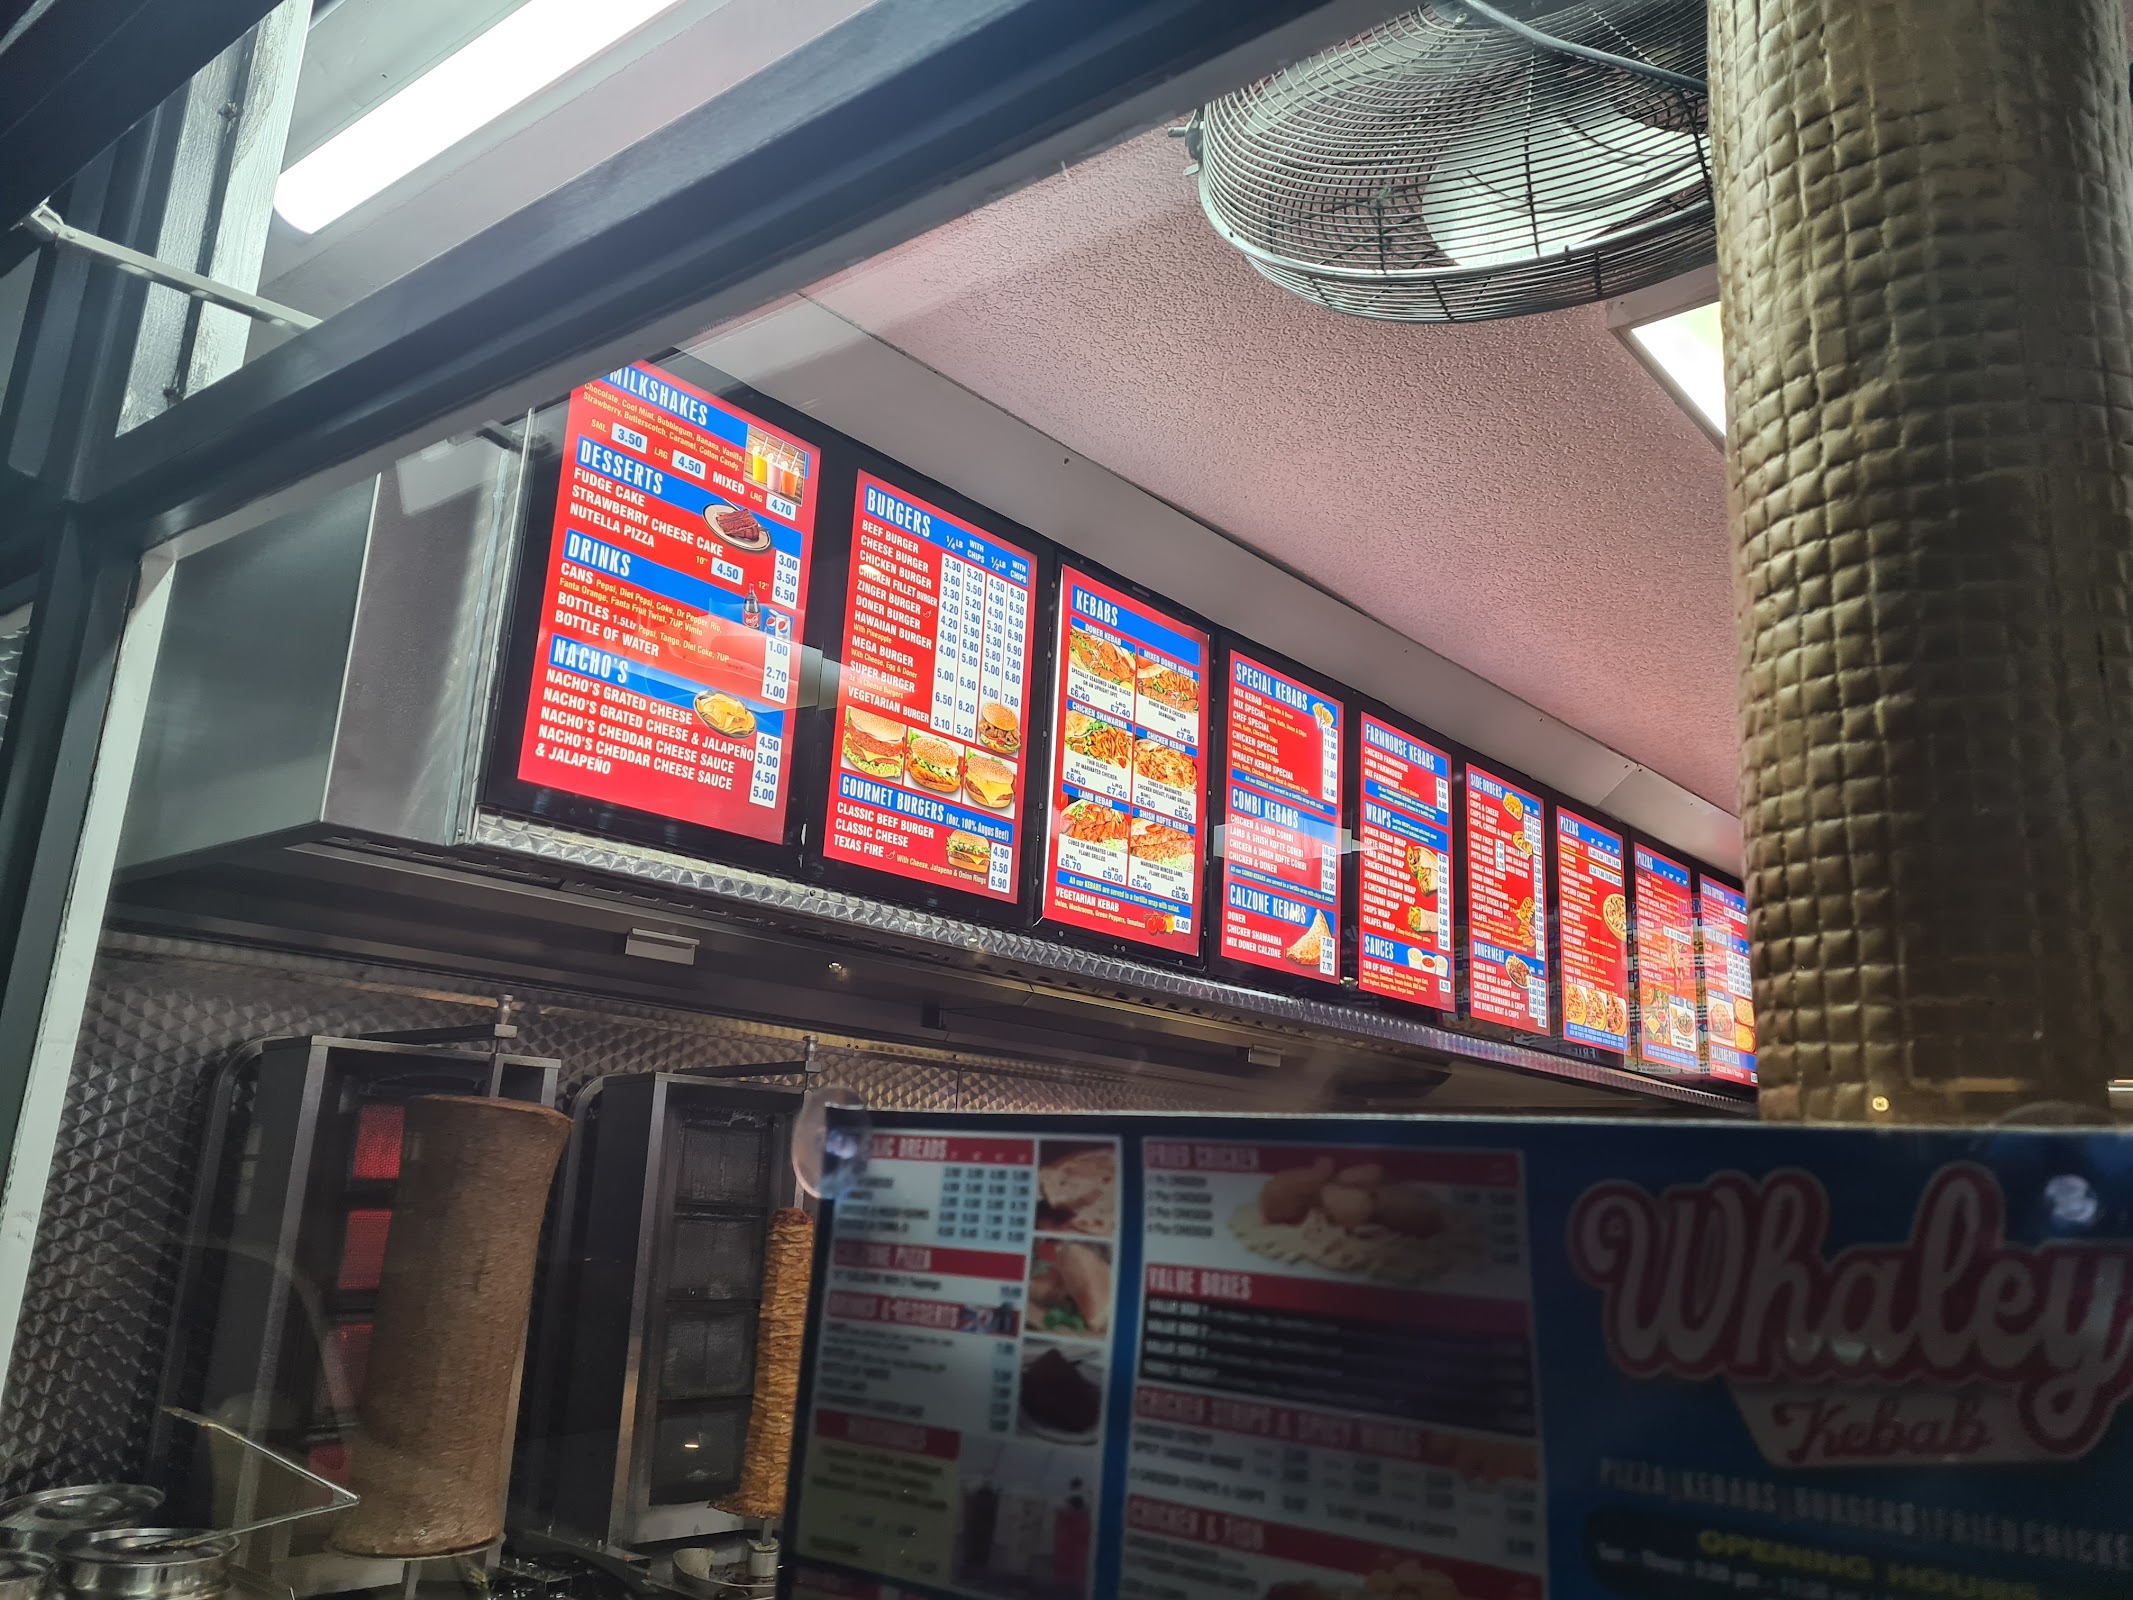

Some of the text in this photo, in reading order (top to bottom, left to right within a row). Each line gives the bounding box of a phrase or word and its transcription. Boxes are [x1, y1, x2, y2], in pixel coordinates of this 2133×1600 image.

[609, 367, 709, 426] MILKSHAKES
[582, 391, 739, 472] Strawberry, Butterscotch, Caramel, Cotton Candy.
[621, 398, 637, 413] Cool
[638, 406, 655, 421] Mint,
[656, 414, 694, 441] Bubblegum,
[696, 433, 720, 452] Banana,
[721, 446, 744, 463] Vanilla,
[579, 439, 663, 495] DESSERTS
[591, 418, 791, 516] SML 3.50 LRG 4.50 MIXED LRG 4.70
[571, 483, 796, 587] STRAWBERRY CHEESE CAKE 3.50
[573, 466, 797, 571] FUDGE CAKE 3.00
[867, 487, 930, 538] BURGERS
[568, 532, 631, 578] DRINKS
[569, 501, 621, 533] NUTELLA
[623, 523, 655, 547] PIZZA
[716, 561, 738, 580] 4.50
[774, 585, 795, 603] 6.50
[859, 548, 931, 590] CHICKEN BURGER
[860, 533, 960, 587] CHEESE BURGER 3.60
[862, 519, 1024, 602] BEEF BURGER 3.30 5.20 4.50 6.30
[559, 576, 580, 592] Fanta
[580, 584, 608, 604] Orange,
[610, 595, 630, 610] Fanta
[631, 602, 647, 616] Fruit
[647, 609, 667, 624] Twist,
[684, 621, 703, 638] Vimto
[560, 561, 788, 657] CANS Pepsi, Diet Pepsi, Coke, Dr Pepper, Rio, 1.00
[855, 594, 920, 630] DONER BURGER
[857, 579, 920, 615] ZINGER BURGER
[1076, 589, 1117, 627] KEBABS
[555, 608, 785, 699] BOTTLE OF WATER 1.00
[557, 590, 787, 683] BOTTLES 1.5Ltr Pepsi, Tango, Diet Coke, 7UP 2.70
[851, 634, 913, 667] MEGA BURGER
[854, 609, 931, 650] HAWAIIAN BURGER
[1085, 622, 1121, 646] DONER KEBAB
[553, 636, 629, 685] NACHO'S
[1235, 660, 1307, 712] SPECIAL KEBABS
[543, 686, 778, 768] NACHO'S GRATED CHEESE & JALAPEÑO 5.00
[546, 667, 779, 752] NACHO'S GRATED CHEESE 4.50
[847, 684, 973, 738] VEGETARIAN BURGER 3.10 5.20
[1070, 686, 1130, 718] £6.40 £7.40
[1072, 700, 1126, 730] CHICKEN SHAWARMA
[1365, 722, 1434, 771] FARMHOUSE KEBABS
[842, 775, 944, 822] GOURMET BURGERS
[1232, 786, 1298, 830] COMBI KEBABS
[1365, 802, 1390, 828] WRAPS
[835, 817, 1007, 874] CLASSIC CHEESE 5.50
[837, 801, 1009, 859] CLASSIC BEEF BURGER 4.90
[1559, 814, 1578, 837] PIZZAS
[833, 833, 1006, 889] TEXAS FIRE 6.90
[1055, 886, 1188, 930] VEGETARIAN KEBAB 6.00
[1227, 910, 1245, 923] DONER
[1229, 884, 1306, 925] CALZONE KEBABS
[1364, 935, 1393, 960] SAUCES
[1147, 1265, 1252, 1300] VALUE BOXES
[1572, 1166, 2133, 1455] Whaley
[1772, 1397, 1992, 1464] Kebab
[1697, 1530, 1873, 1580] OPENING
